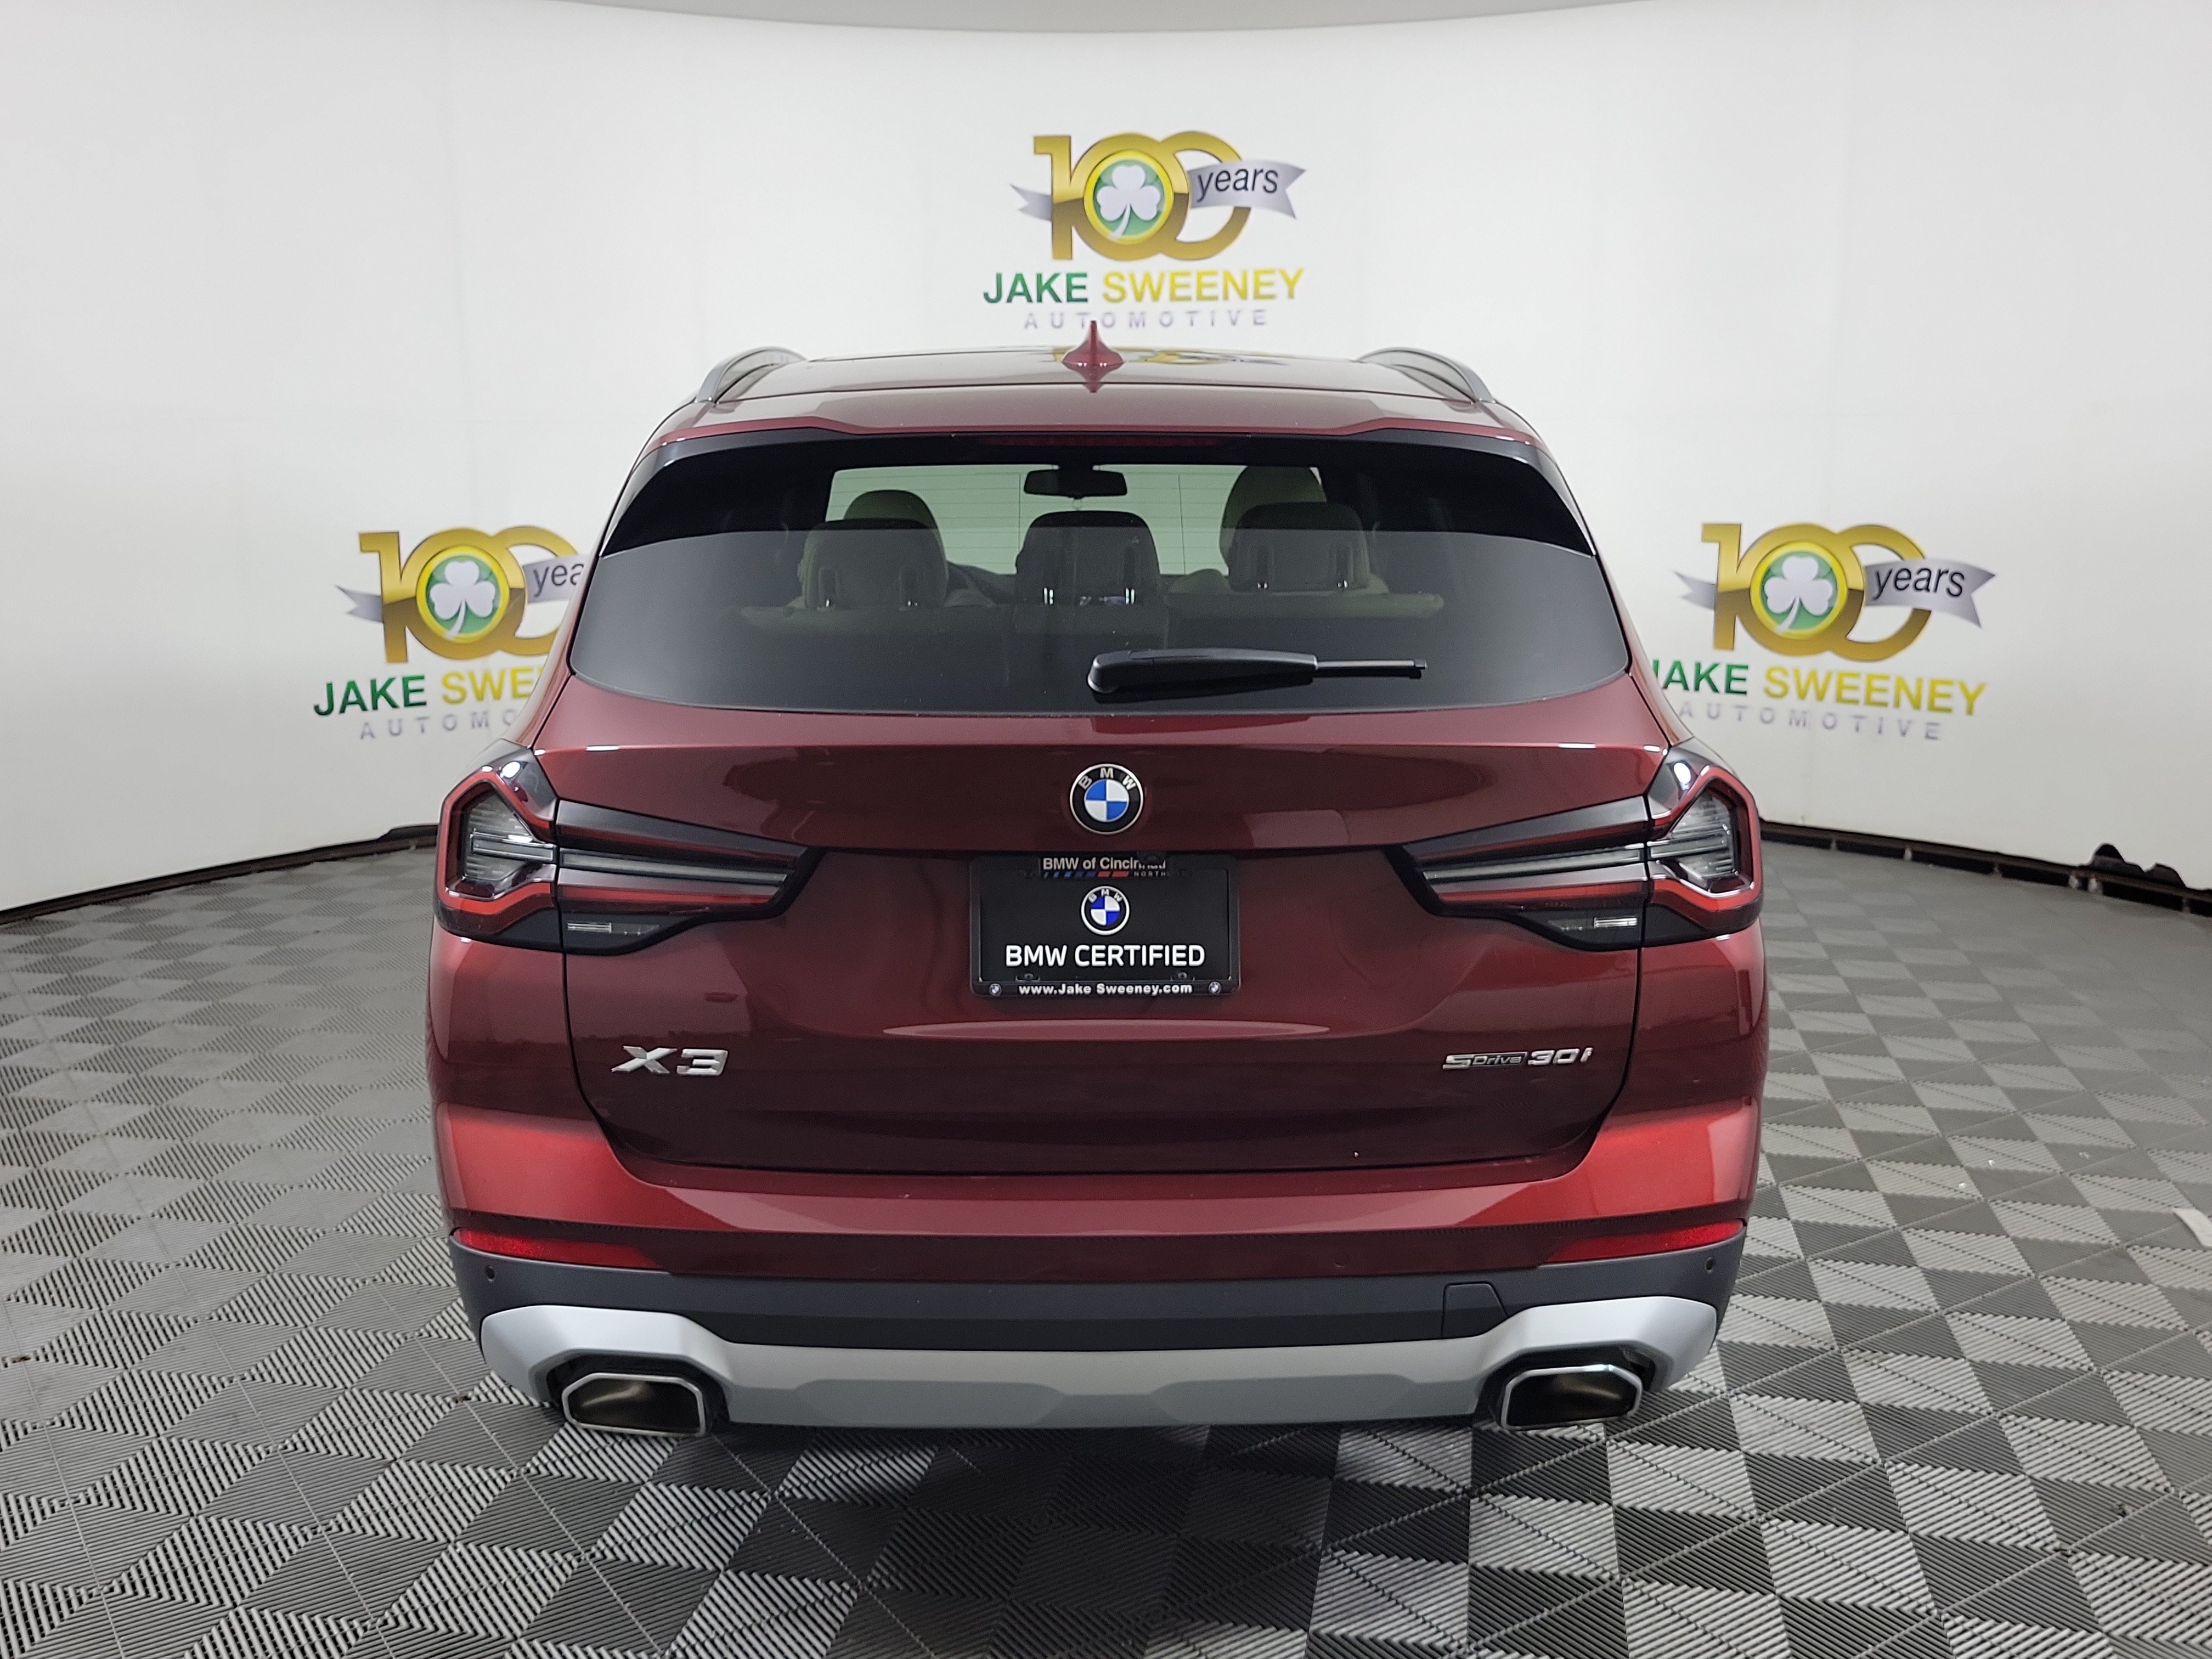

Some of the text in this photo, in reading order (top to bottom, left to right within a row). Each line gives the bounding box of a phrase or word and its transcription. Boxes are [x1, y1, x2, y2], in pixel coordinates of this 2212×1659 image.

[1034, 131, 1252, 261] 100
[1197, 167, 1279, 202] years
[983, 268, 1305, 303] JAKE SWEENEY
[1024, 309, 1268, 329] AUTOMOTIVE
[1701, 523, 1933, 662] 100
[1873, 566, 1966, 602] years
[313, 674, 428, 717] JAKE
[1762, 665, 1987, 716] SWEENEY
[1679, 701, 1942, 741] AUTOMOTIVE
[1078, 767, 1136, 790] BMW
[1043, 857, 1079, 870] BMW
[1082, 857, 1097, 870] of
[1088, 888, 1123, 903] BMW
[1005, 944, 1205, 967] BMW CERTIFIED
[1018, 983, 1092, 995] www.Jake
[1096, 983, 1193, 996] Sweeney.com
[611, 1045, 729, 1076] X3
